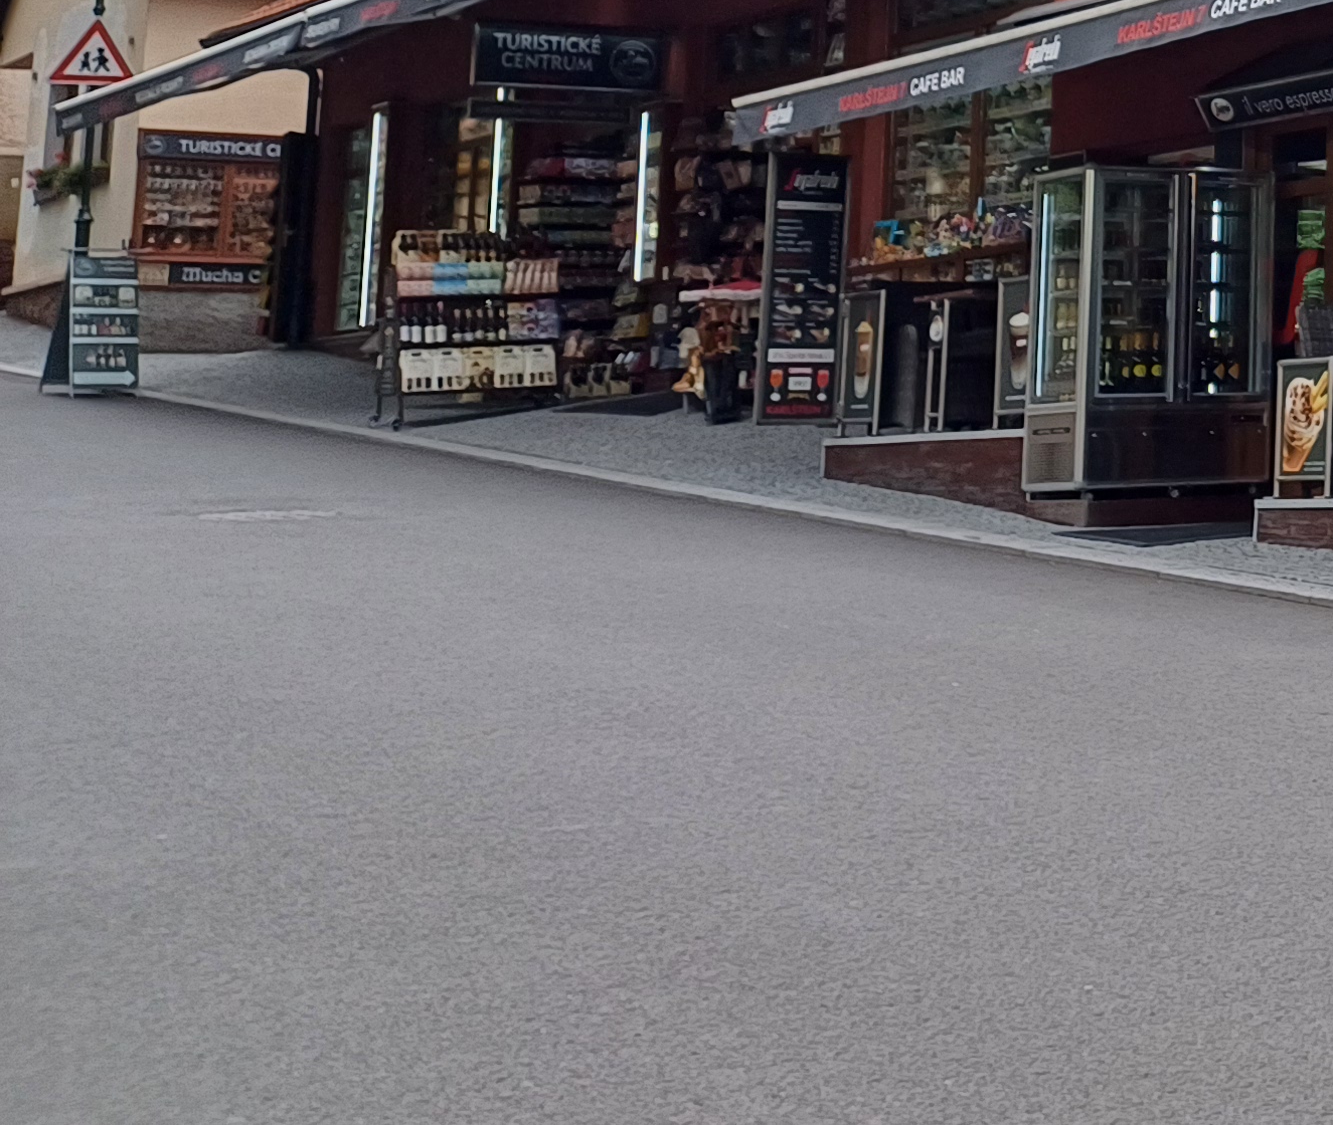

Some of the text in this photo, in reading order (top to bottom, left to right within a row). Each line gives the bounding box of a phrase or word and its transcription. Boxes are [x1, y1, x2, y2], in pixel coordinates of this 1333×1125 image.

[1116, 7, 1196, 44] KARLŠTEJN
[492, 31, 601, 56] TURISTICKÉ
[501, 52, 594, 73] CENTRUM
[909, 72, 940, 97] CAFE
[940, 66, 966, 89] BAR
[1241, 95, 1254, 116] il
[1254, 97, 1284, 115] vero
